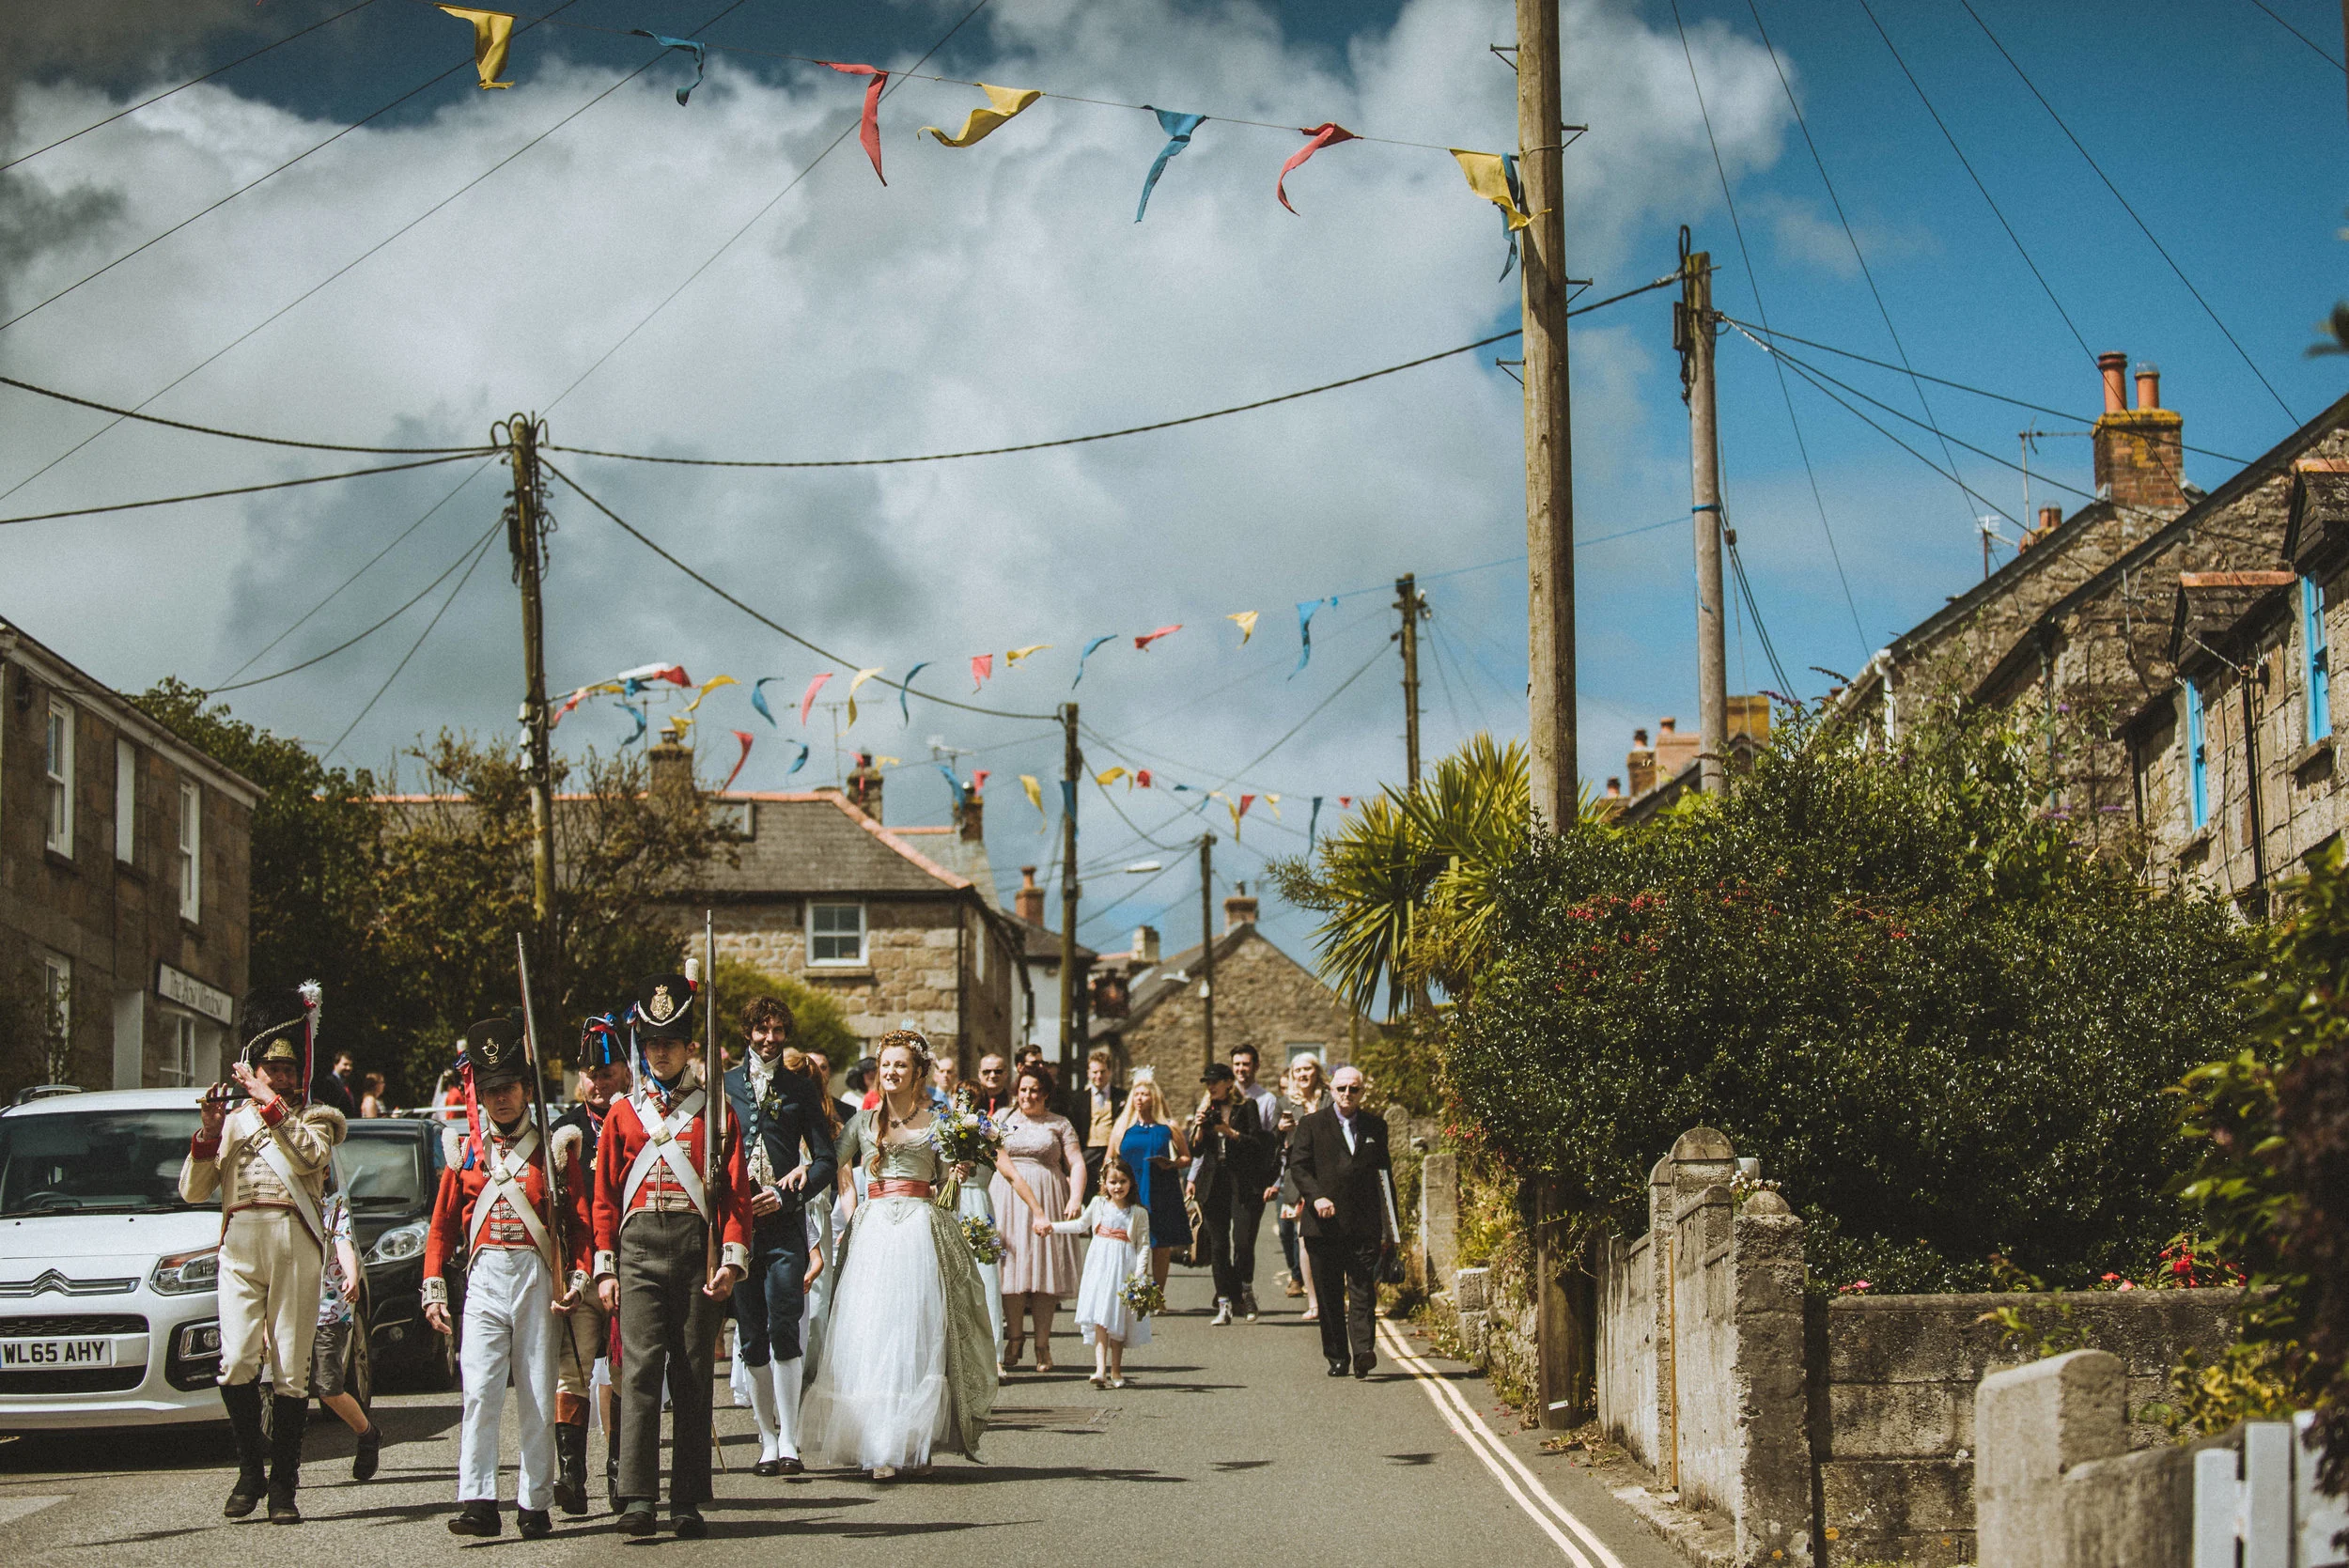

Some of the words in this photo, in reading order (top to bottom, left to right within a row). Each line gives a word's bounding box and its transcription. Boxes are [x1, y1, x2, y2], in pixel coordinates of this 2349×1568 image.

[489, 1056, 499, 1064] 32
[4, 1343, 57, 1363] WL65
[65, 1341, 104, 1362] AHY
